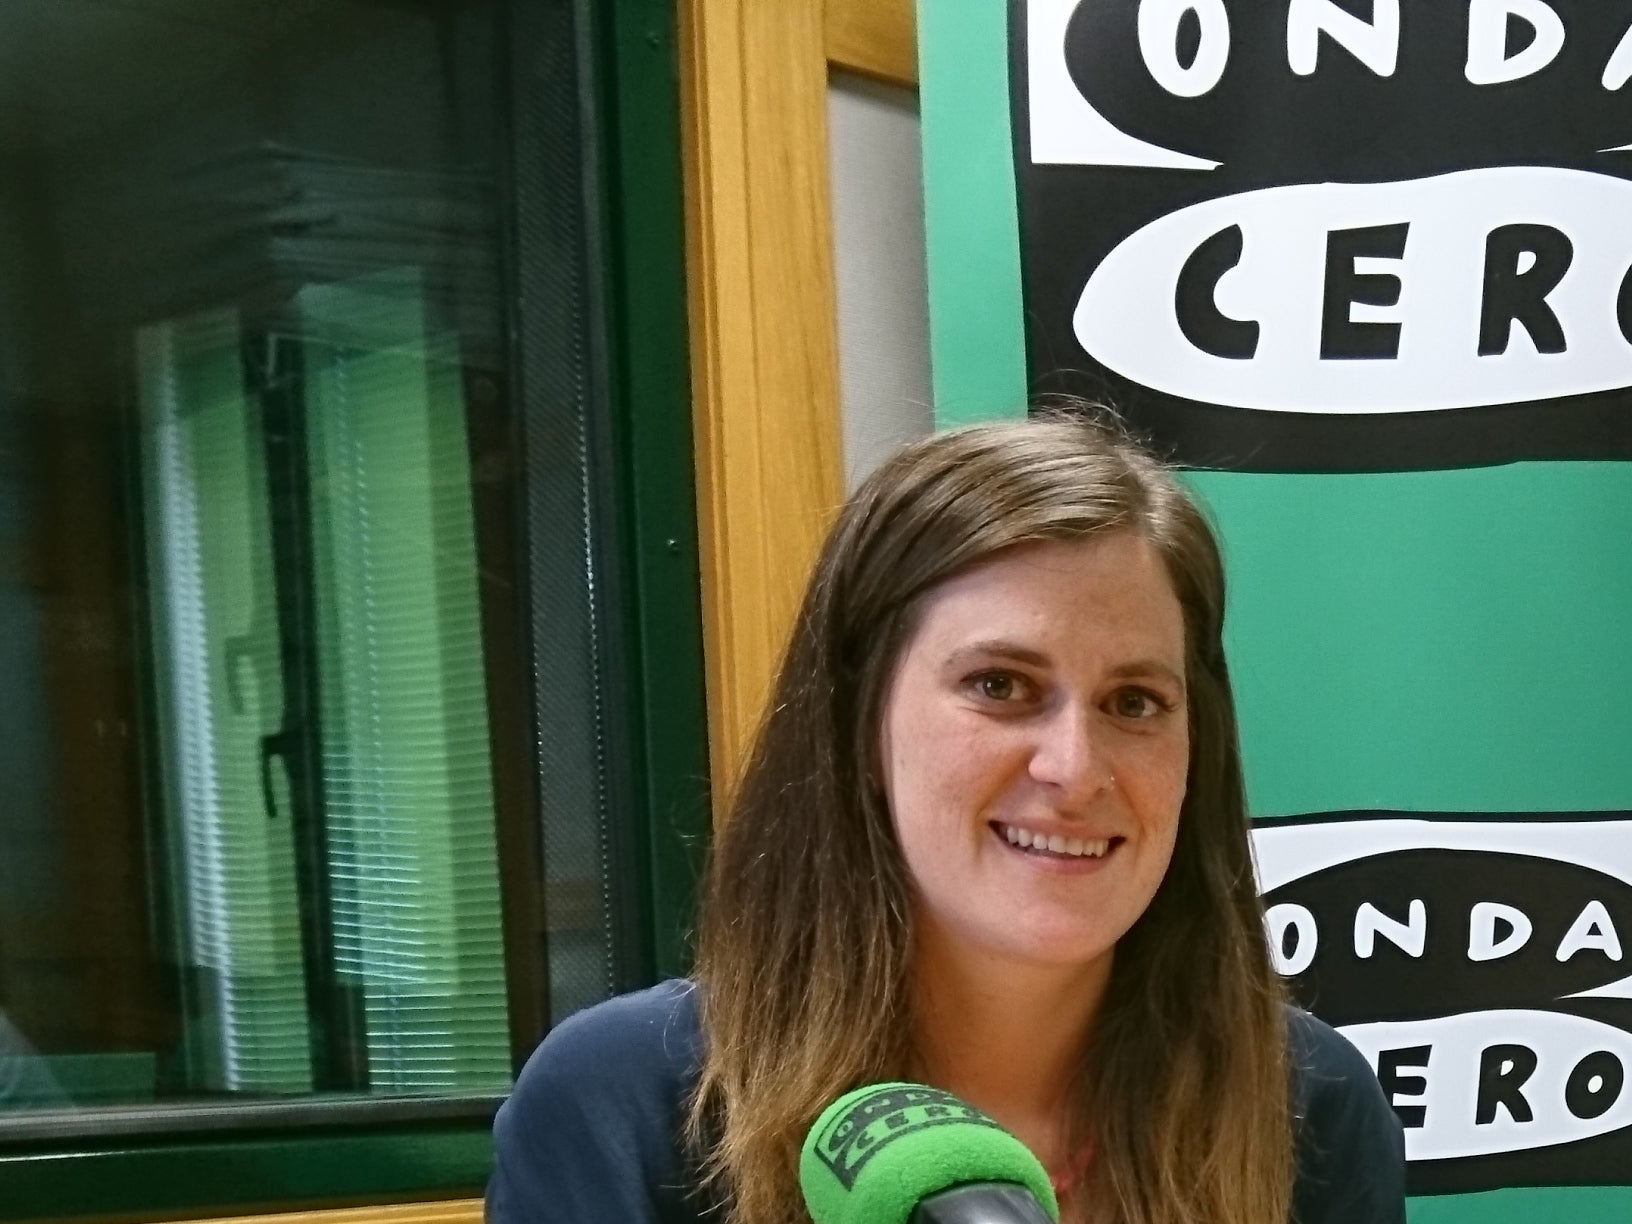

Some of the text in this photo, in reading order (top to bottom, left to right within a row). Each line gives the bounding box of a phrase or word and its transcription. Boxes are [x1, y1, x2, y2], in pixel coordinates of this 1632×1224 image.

[1264, 898, 1624, 977] ONDA
[836, 1092, 959, 1137] OND
[1376, 1042, 1625, 1129] ERO
